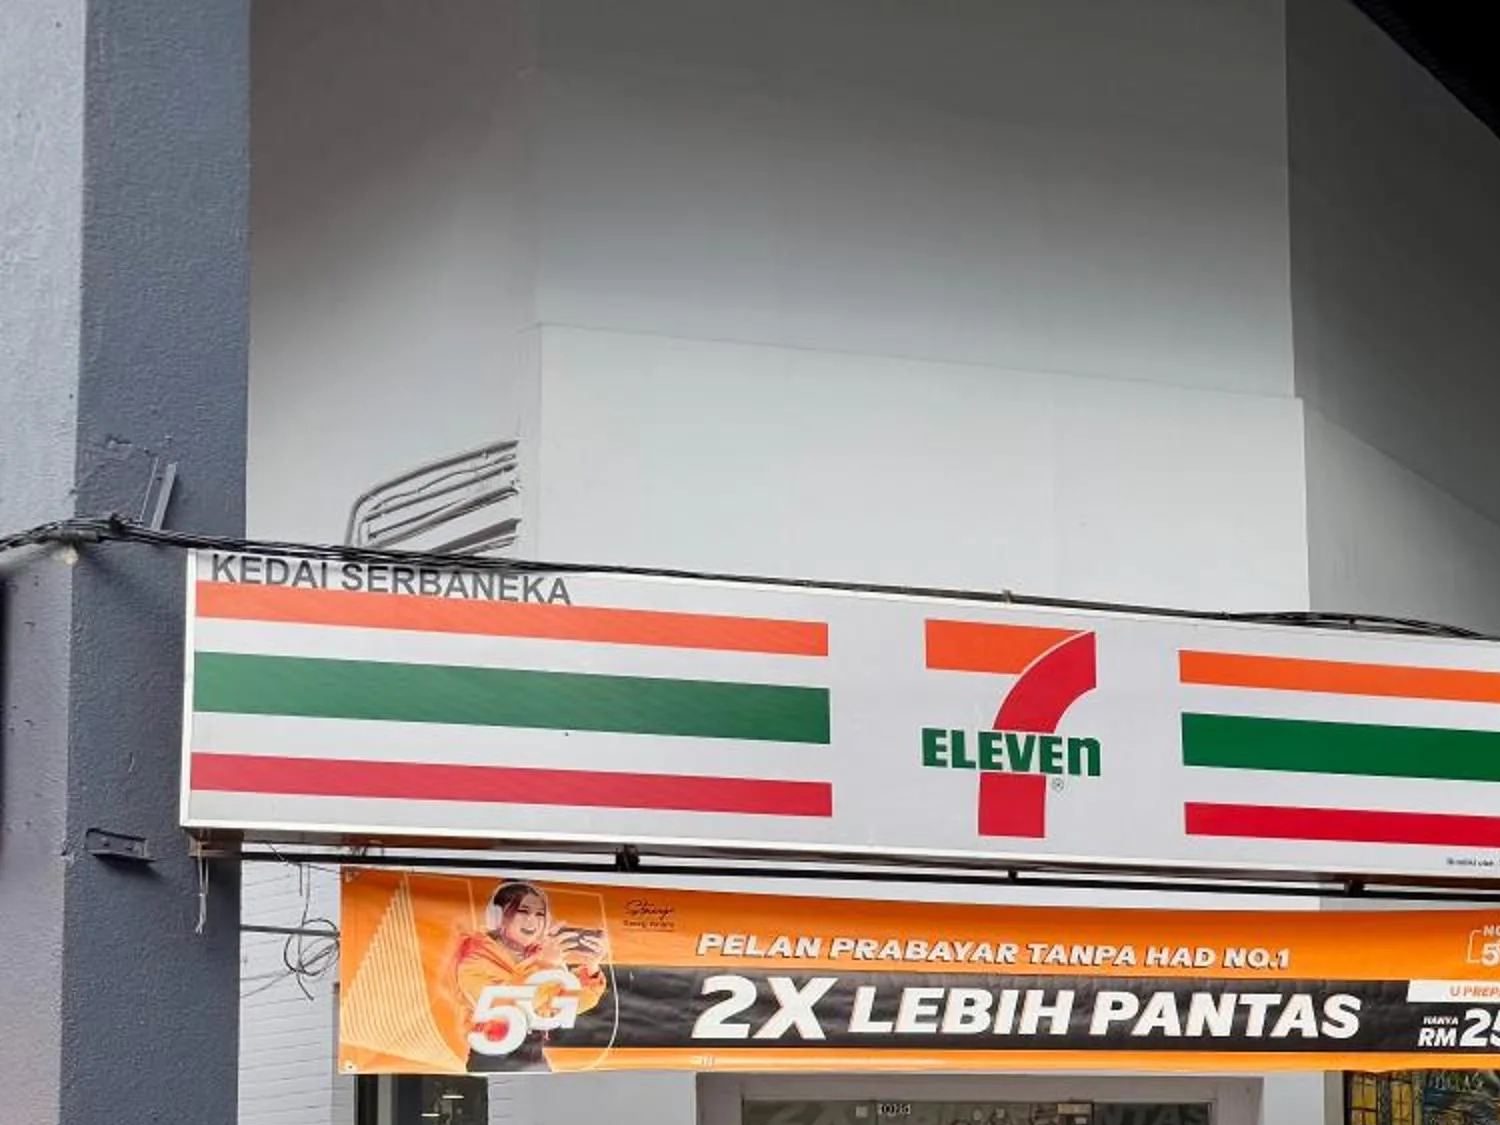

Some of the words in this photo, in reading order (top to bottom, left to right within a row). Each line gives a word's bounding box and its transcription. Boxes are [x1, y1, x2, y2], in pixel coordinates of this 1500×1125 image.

[211, 553, 329, 590] KEDAI
[341, 563, 572, 606] SERBANEKA
[924, 618, 1097, 838] 7
[697, 933, 822, 958] PELAN
[829, 937, 1017, 964] PRABAYAR
[1026, 943, 1137, 967] TANPA
[1144, 947, 1217, 968] HAD
[1222, 948, 1291, 970] NO.1
[468, 970, 582, 1056] 5G
[691, 975, 839, 1040] 2X
[847, 986, 1075, 1035] LEBIH
[1088, 991, 1363, 1039] PANTAS
[1423, 1015, 1459, 1026] HANYA
[1417, 1028, 1457, 1047] RM
